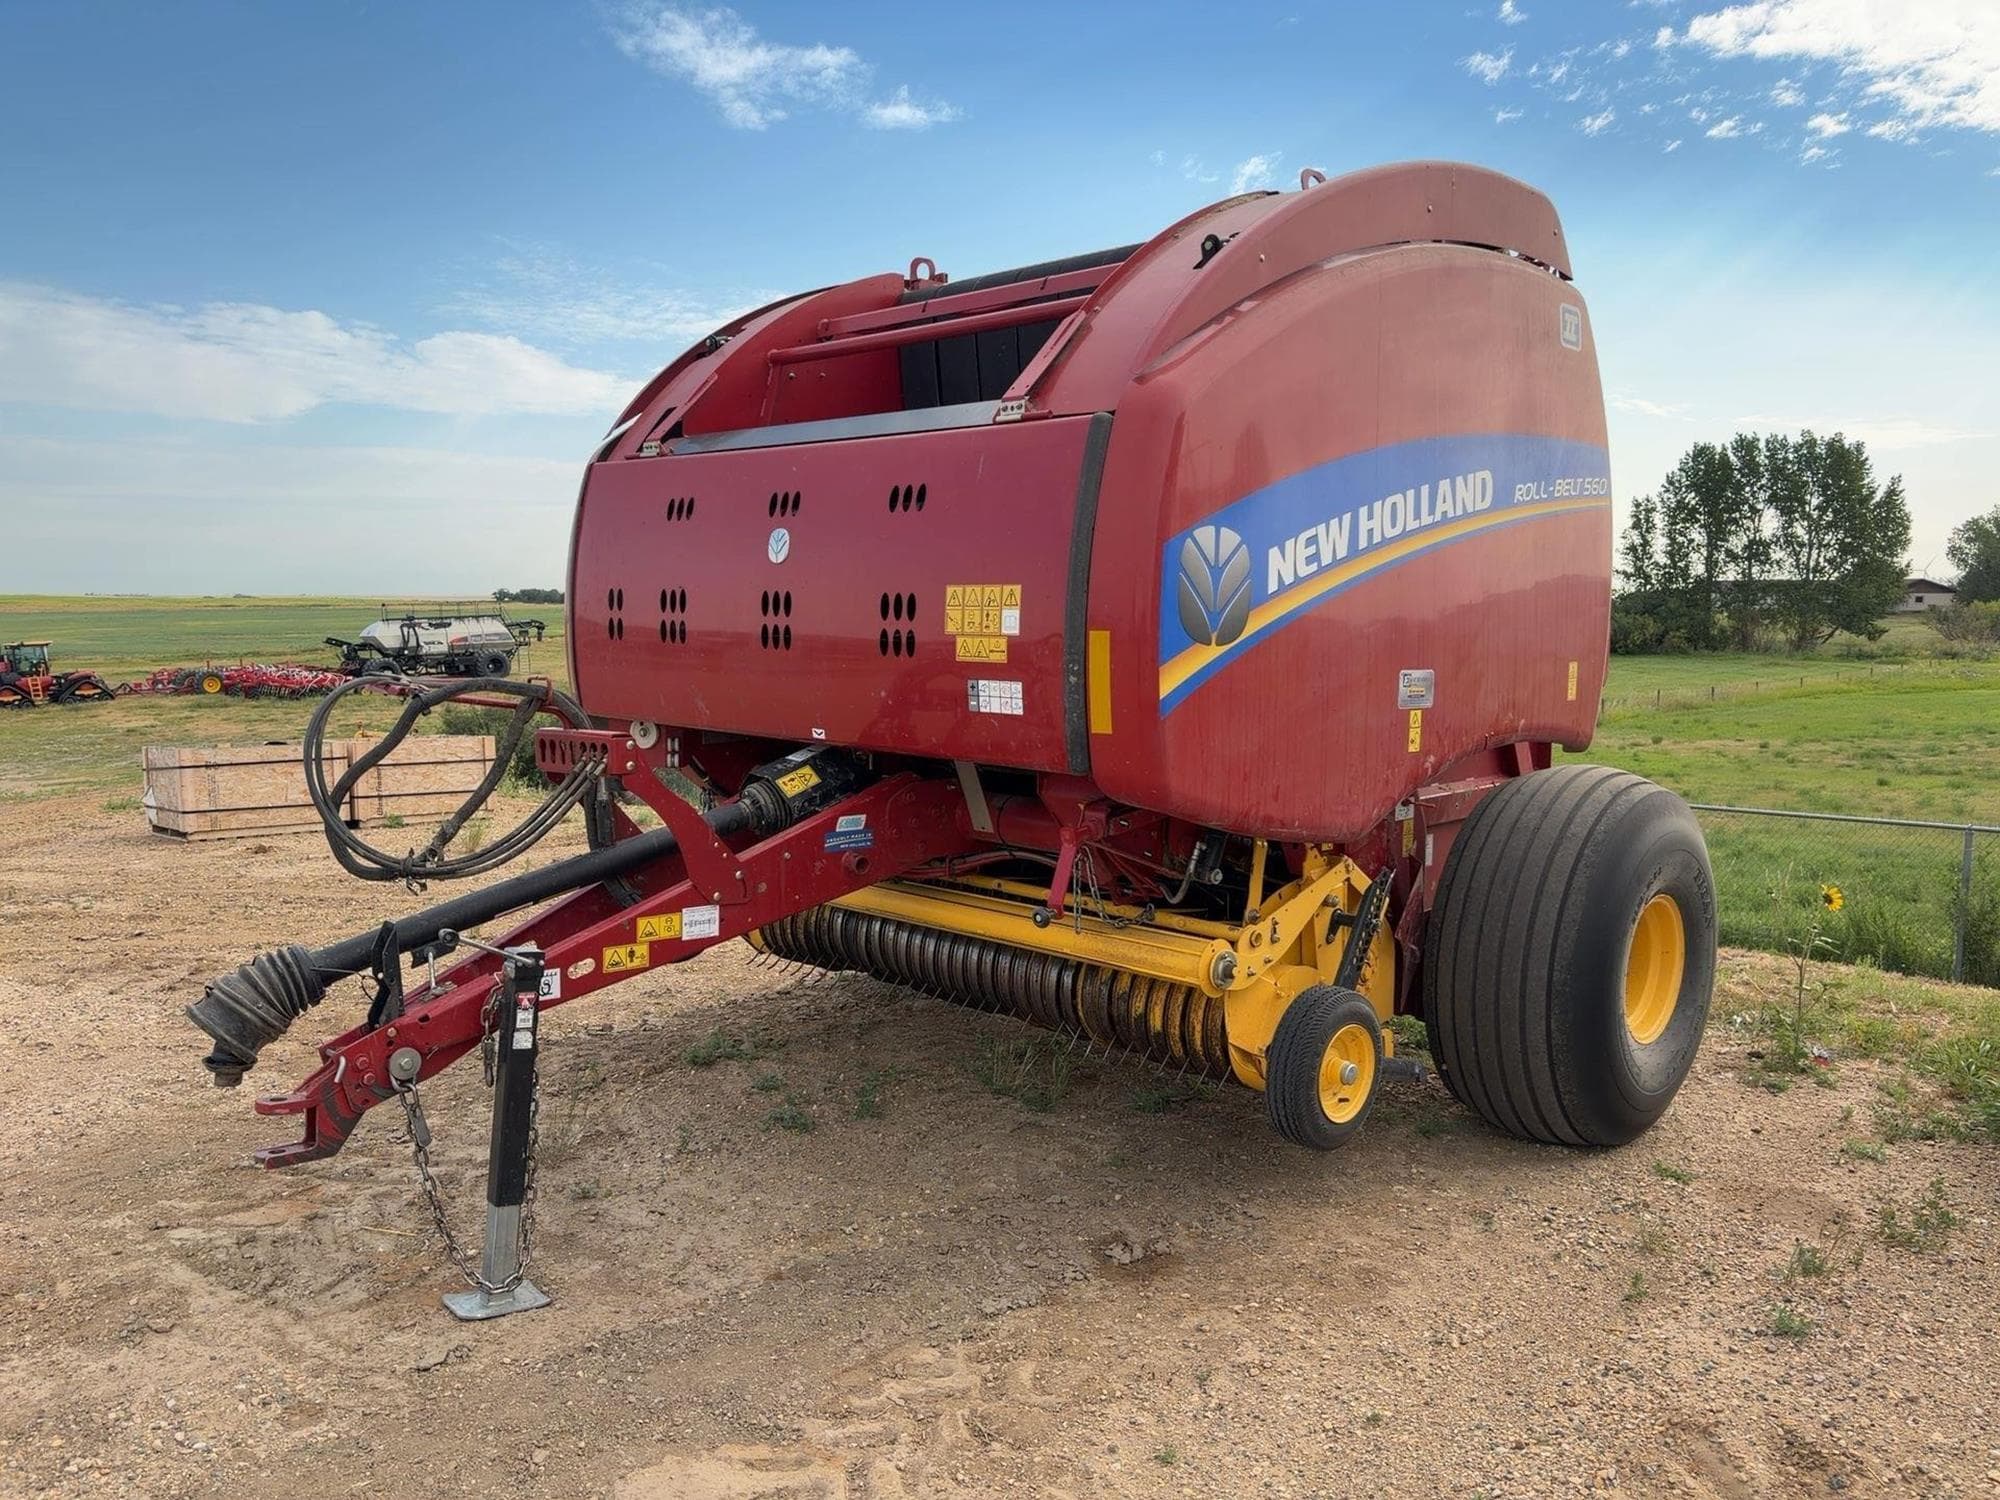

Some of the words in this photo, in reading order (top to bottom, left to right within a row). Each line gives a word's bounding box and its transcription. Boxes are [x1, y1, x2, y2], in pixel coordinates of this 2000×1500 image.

[1513, 478, 1584, 504] ROLL-BELT
[1583, 478, 1607, 496] 560
[1267, 511, 1352, 595] NEW
[1358, 469, 1494, 551] HOLLAND
